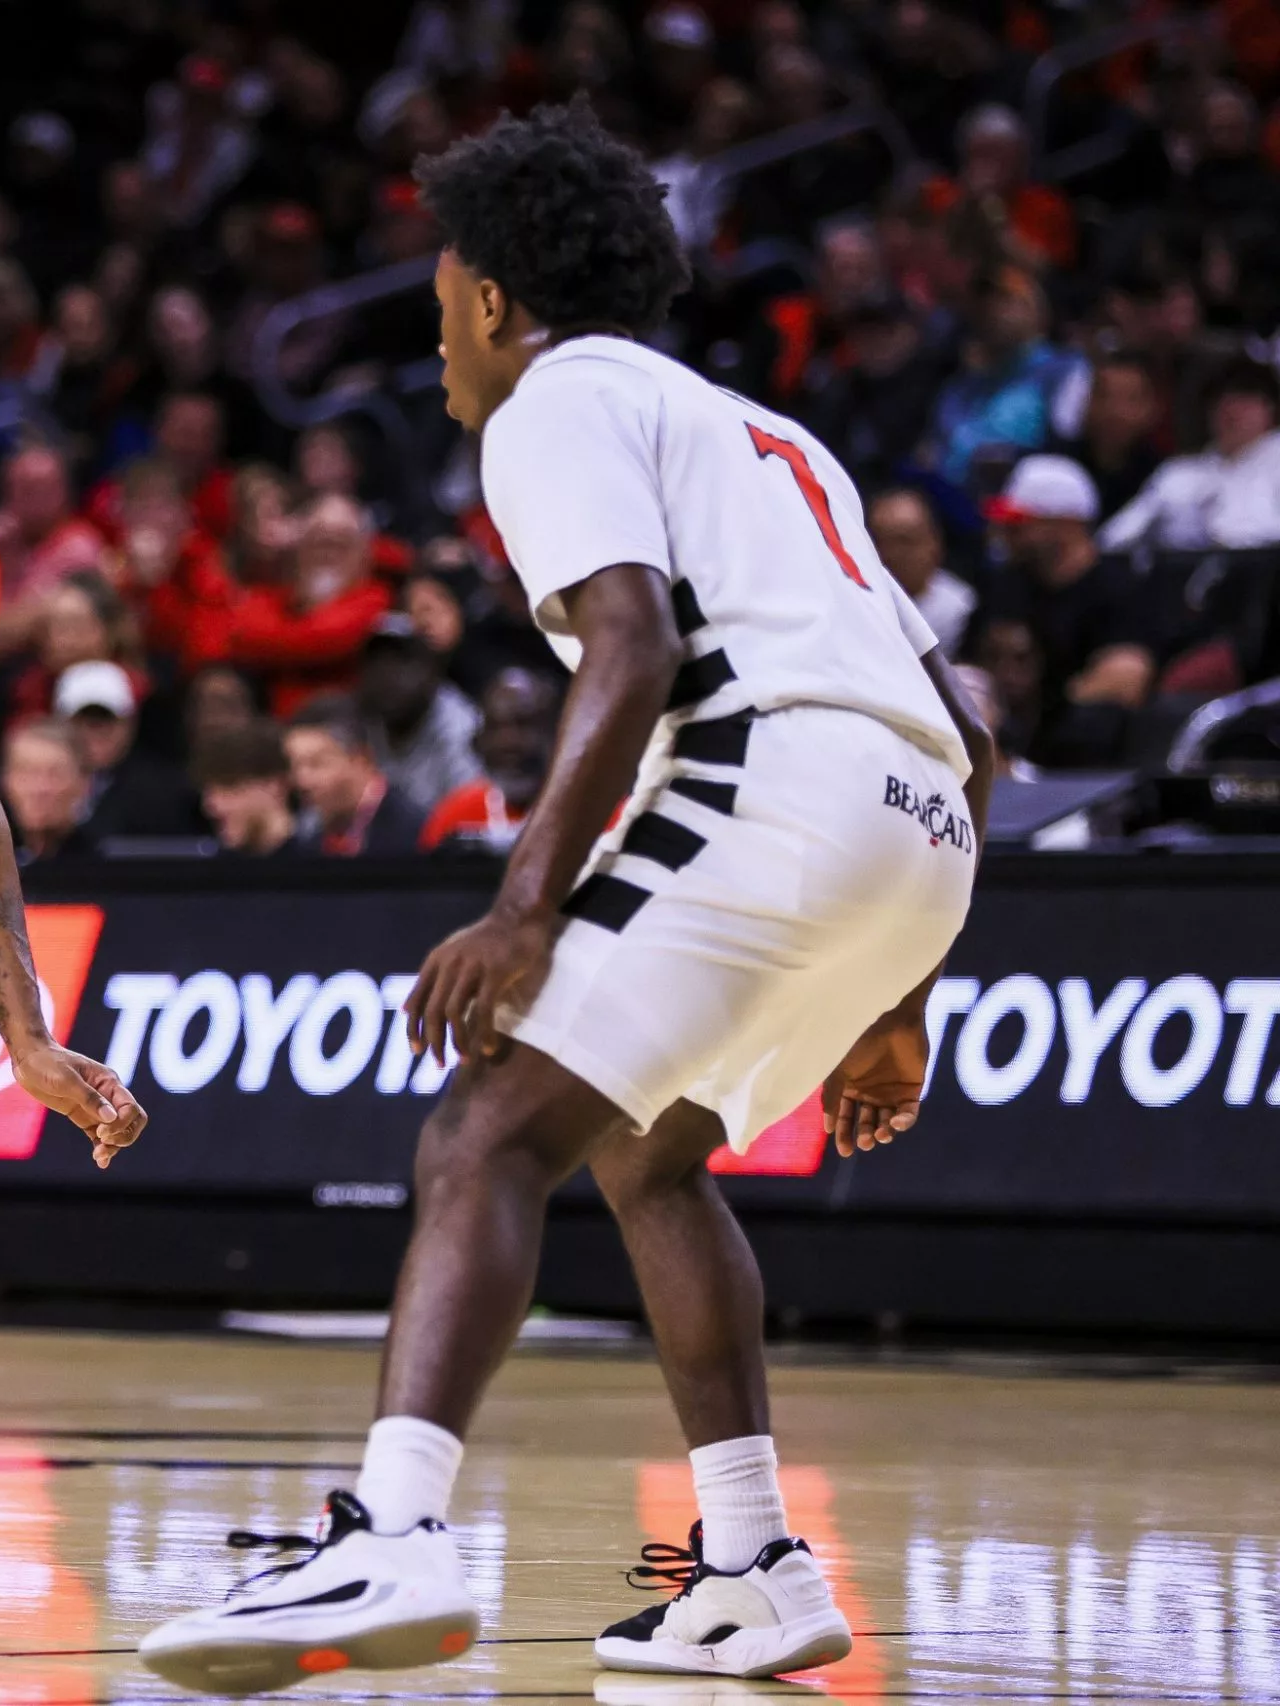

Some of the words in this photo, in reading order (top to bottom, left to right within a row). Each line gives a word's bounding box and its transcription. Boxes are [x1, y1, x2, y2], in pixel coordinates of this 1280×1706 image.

[743, 421, 873, 593] 7
[103, 968, 460, 1096] TOYOT
[919, 972, 1280, 1107] TOYOT
